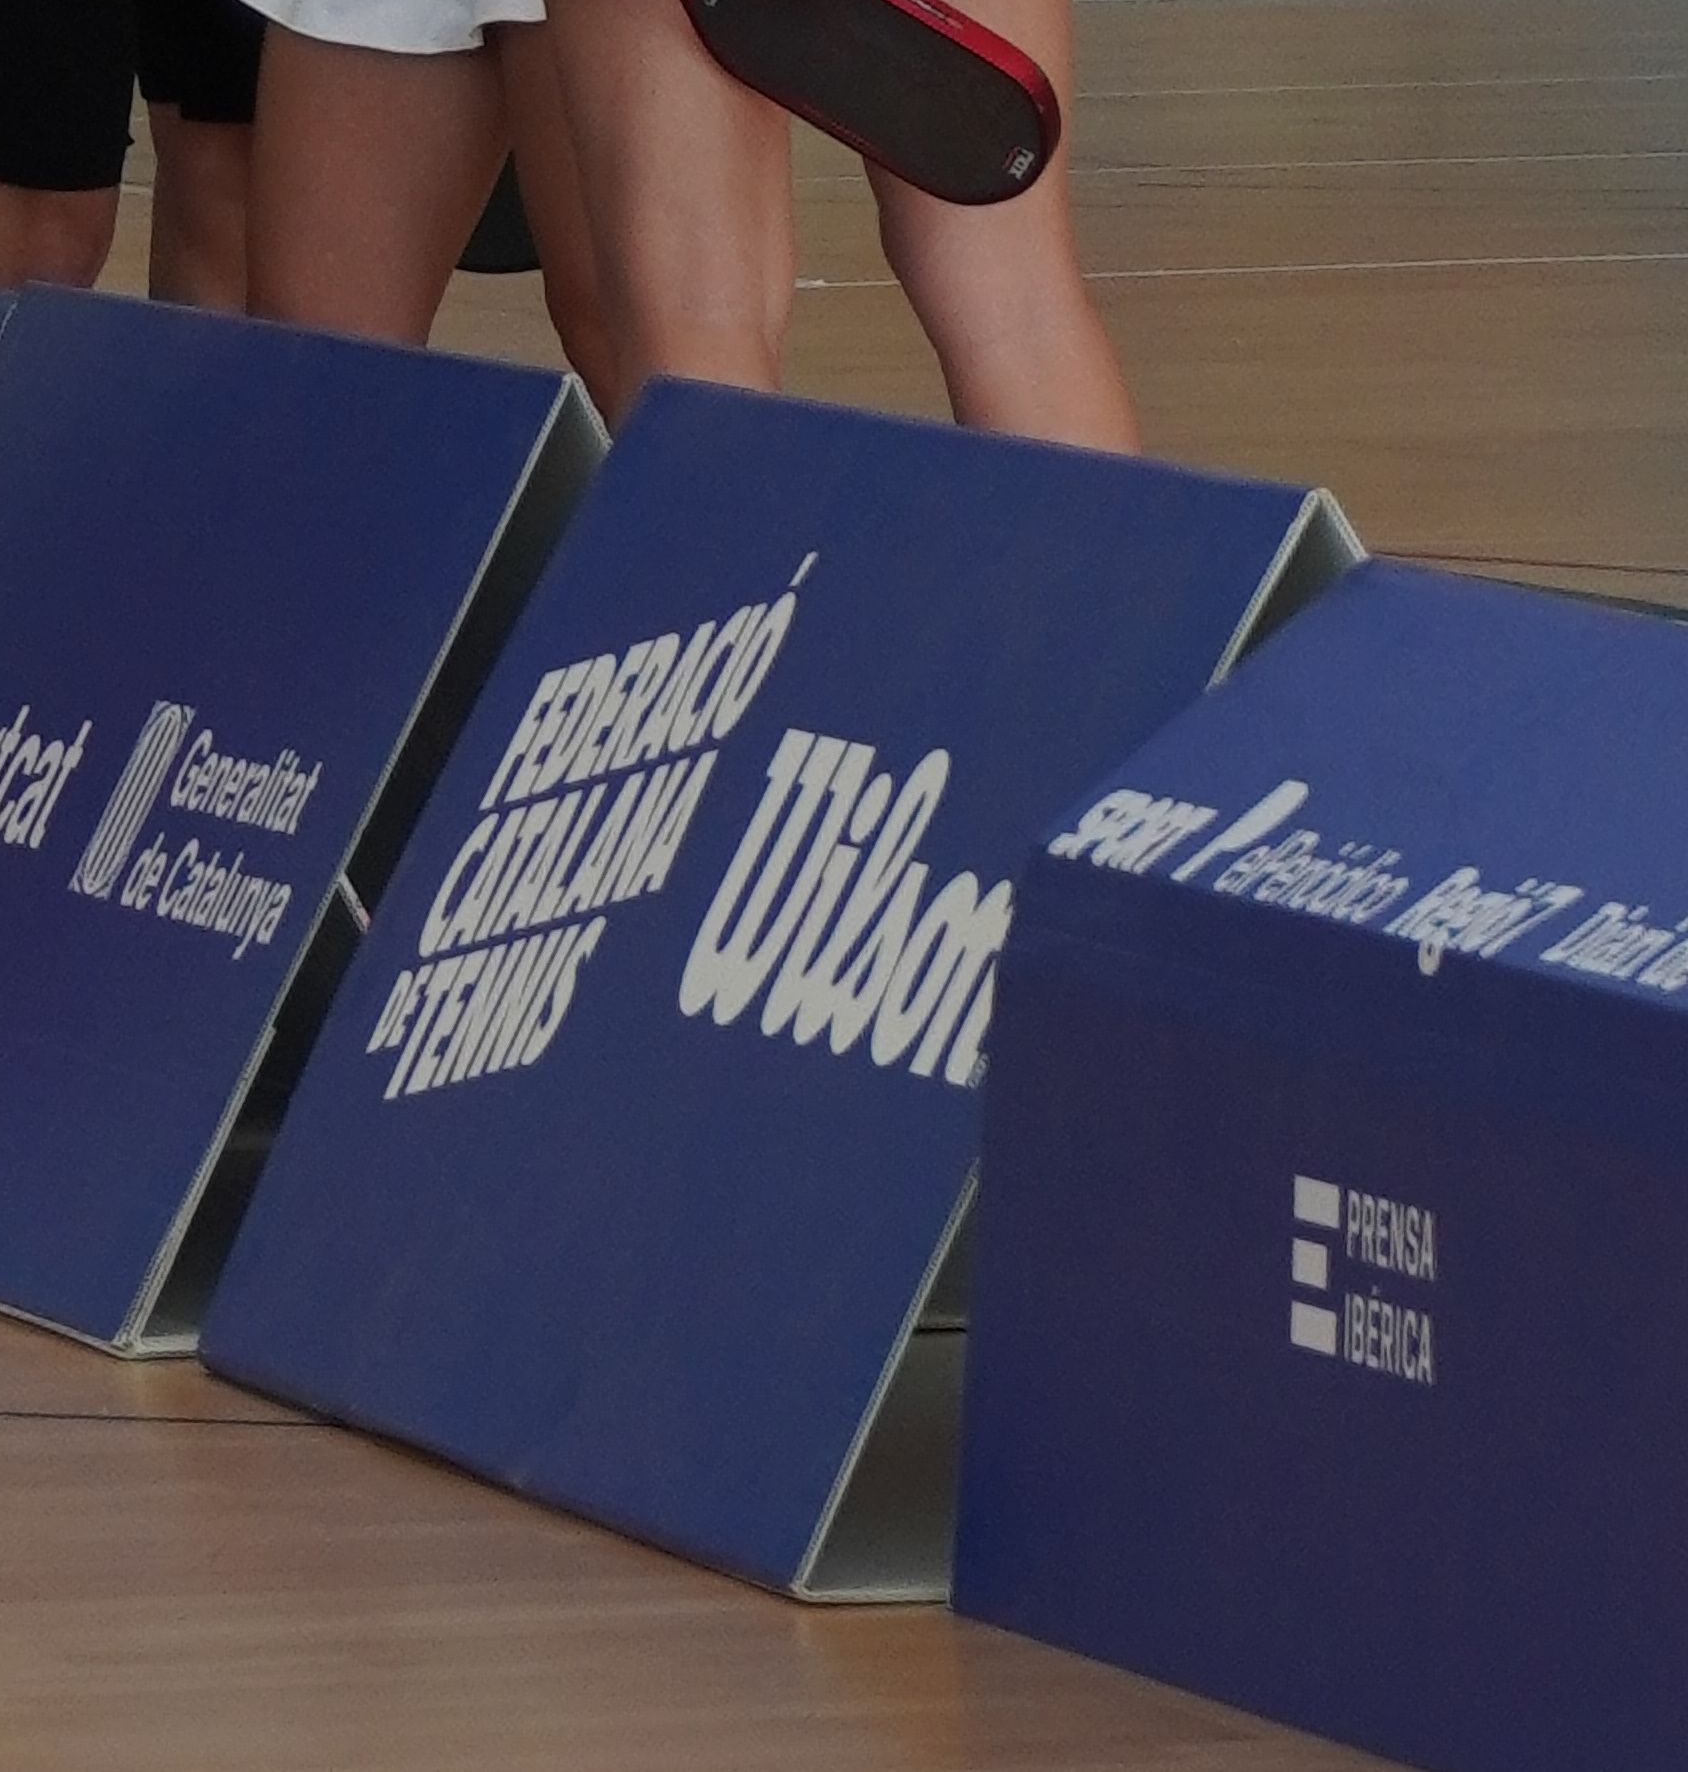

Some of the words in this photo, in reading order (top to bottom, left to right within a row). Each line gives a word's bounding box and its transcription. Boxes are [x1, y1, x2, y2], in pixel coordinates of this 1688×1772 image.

[480, 550, 819, 811] FEDERACIÓ
[170, 729, 324, 836] Generalitat
[120, 832, 165, 911] de
[157, 837, 293, 961] Catalunya
[419, 748, 719, 958] CATALANA
[679, 728, 1013, 1088] Wilson
[365, 969, 414, 1054] DE
[383, 915, 607, 1101] TENNIS
[1346, 1188, 1437, 1283] PRENSA
[1343, 1284, 1434, 1387] IBÉRICA
